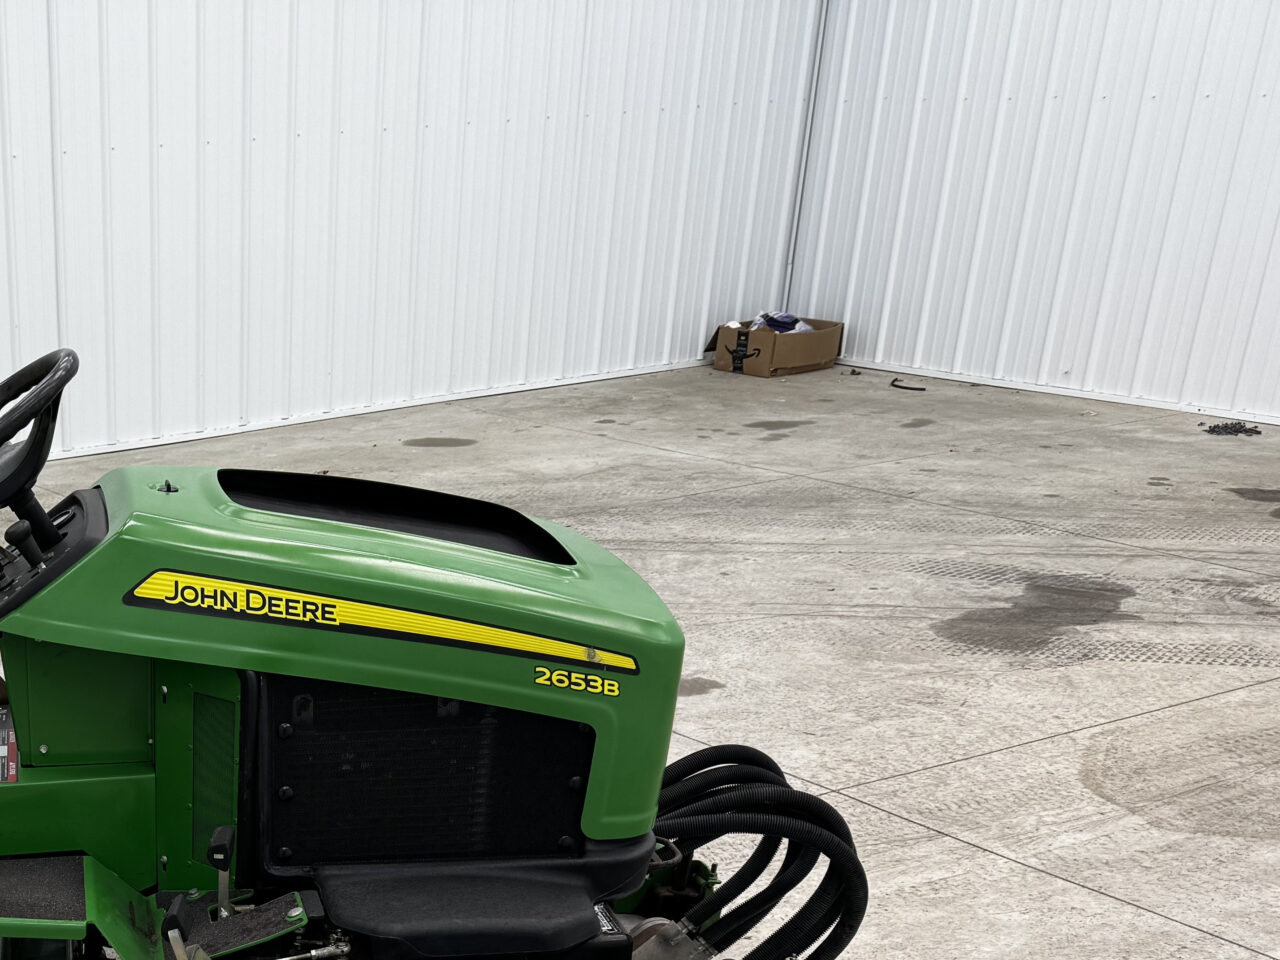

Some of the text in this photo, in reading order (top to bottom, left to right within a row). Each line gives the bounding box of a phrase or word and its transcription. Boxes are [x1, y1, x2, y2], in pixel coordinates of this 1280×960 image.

[164, 580, 337, 622] JOHN DEERE
[534, 666, 620, 697] 2653B
